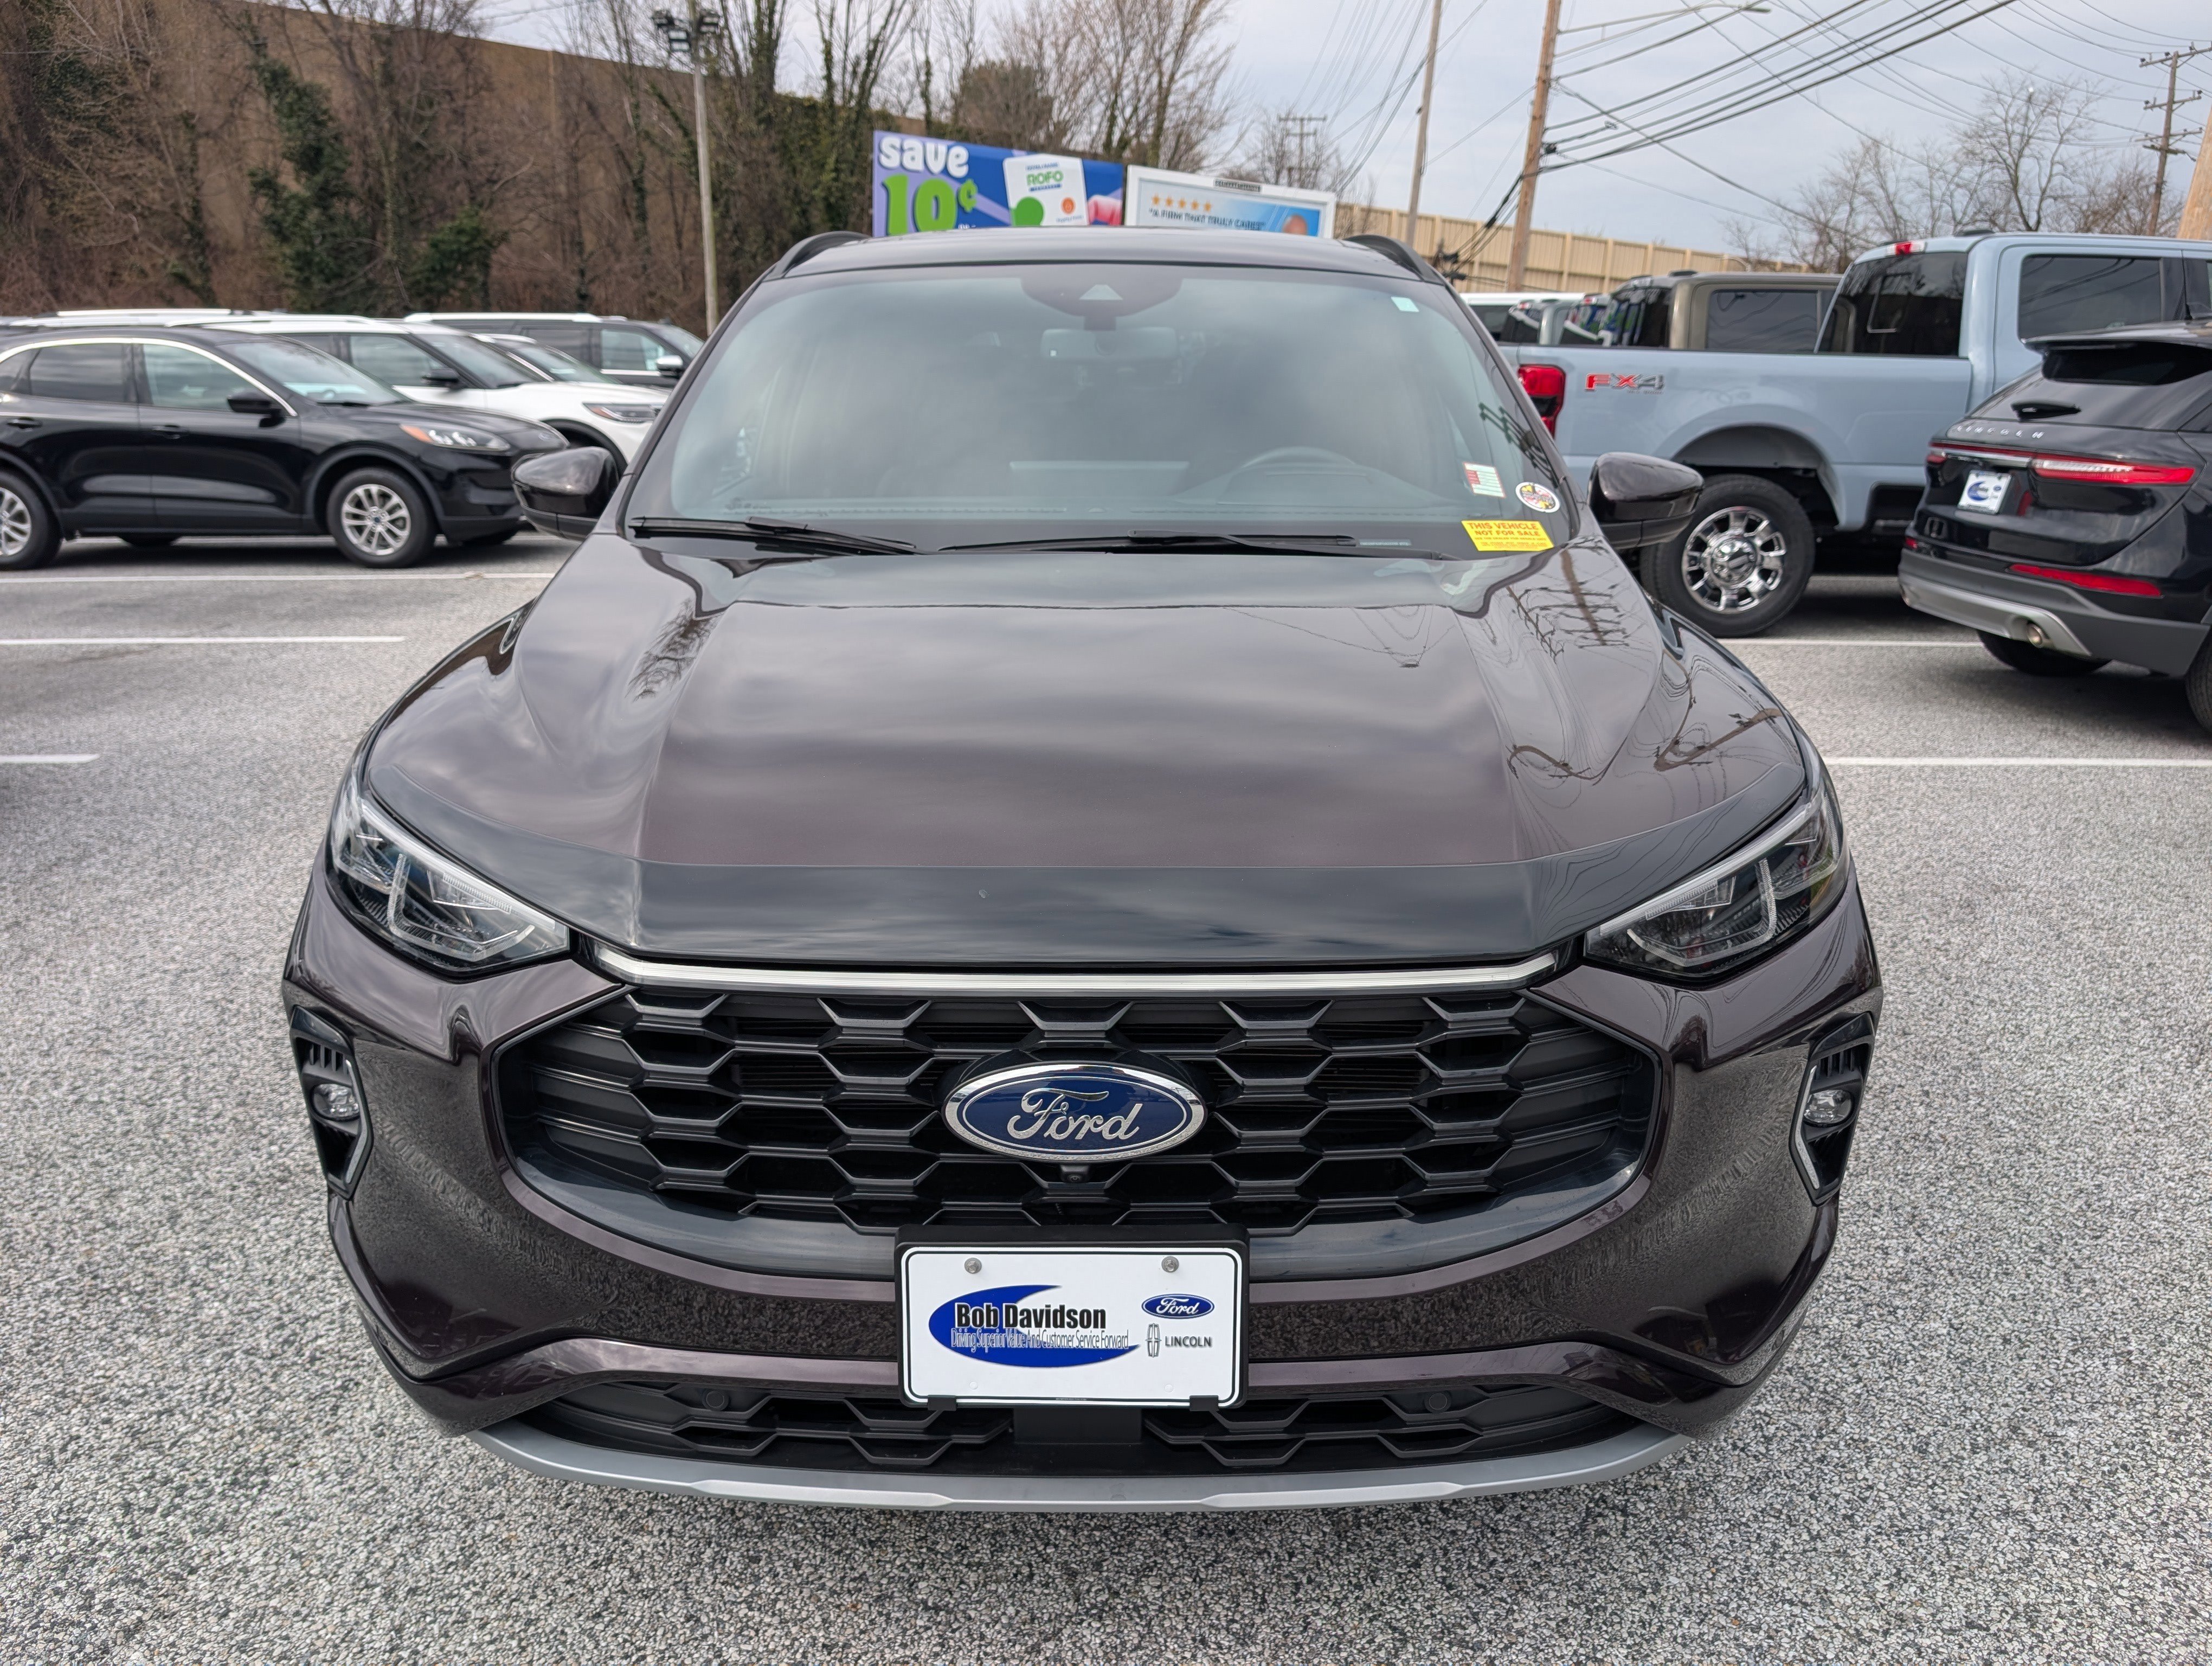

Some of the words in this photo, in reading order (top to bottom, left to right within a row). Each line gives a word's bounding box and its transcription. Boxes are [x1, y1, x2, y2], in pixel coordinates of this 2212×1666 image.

[879, 137, 969, 178] save
[1026, 170, 1063, 185] ROFO
[1585, 373, 1664, 390] FX4
[1957, 426, 2044, 439] LINCOLN
[1007, 1087, 1142, 1140] Ford
[1156, 1297, 1200, 1314] Ford
[956, 1303, 999, 1328] Bob
[1004, 1303, 1106, 1329] Davidson
[951, 1328, 976, 1353] Driving
[976, 1328, 1006, 1353] Superior
[1006, 1329, 1026, 1348] Value
[1026, 1329, 1040, 1348] And
[1041, 1329, 1075, 1348] Customer
[1076, 1329, 1099, 1348] Service
[1101, 1329, 1129, 1348] Forward
[1165, 1336, 1212, 1347] LINCOLN
